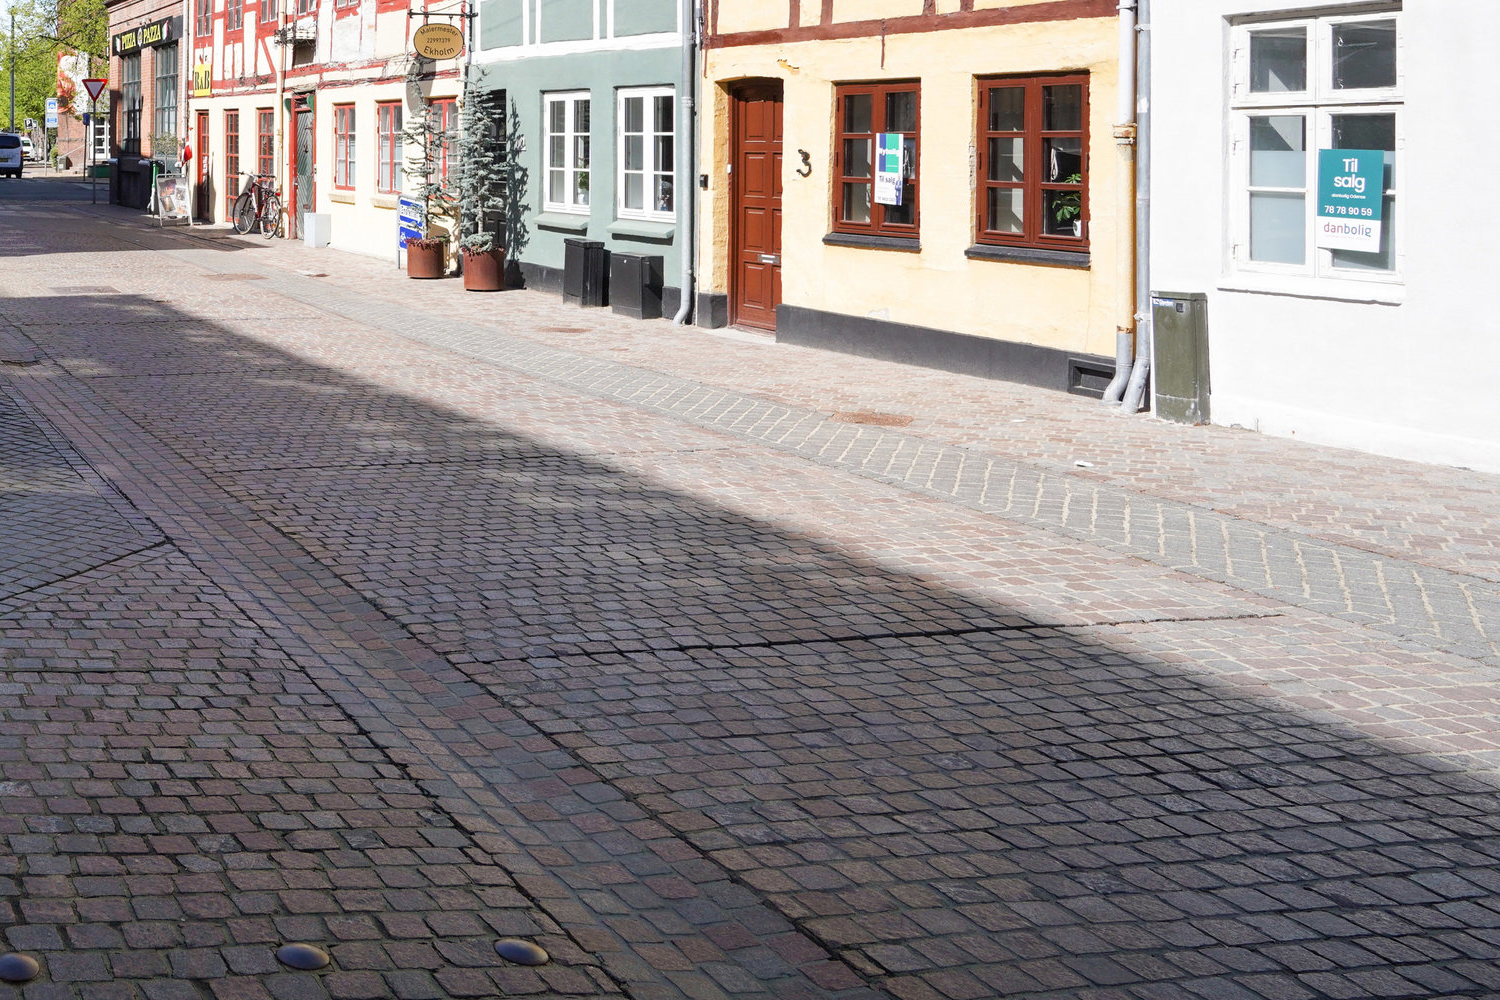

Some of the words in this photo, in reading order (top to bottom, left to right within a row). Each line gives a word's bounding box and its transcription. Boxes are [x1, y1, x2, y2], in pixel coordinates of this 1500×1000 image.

[121, 32, 137, 51] PIZZA
[143, 24, 161, 44] PAZZA
[420, 26, 459, 37] Malermester
[423, 45, 455, 56] Ekholm
[194, 70, 210, 90] R&B
[796, 149, 812, 178] 3
[1343, 158, 1358, 173] Til
[1333, 174, 1365, 193] salg
[1324, 205, 1334, 214] 78
[1336, 206, 1346, 214] 78
[1348, 207, 1359, 215] 90
[1361, 208, 1372, 216] 59
[1323, 222, 1372, 238] danbolig
